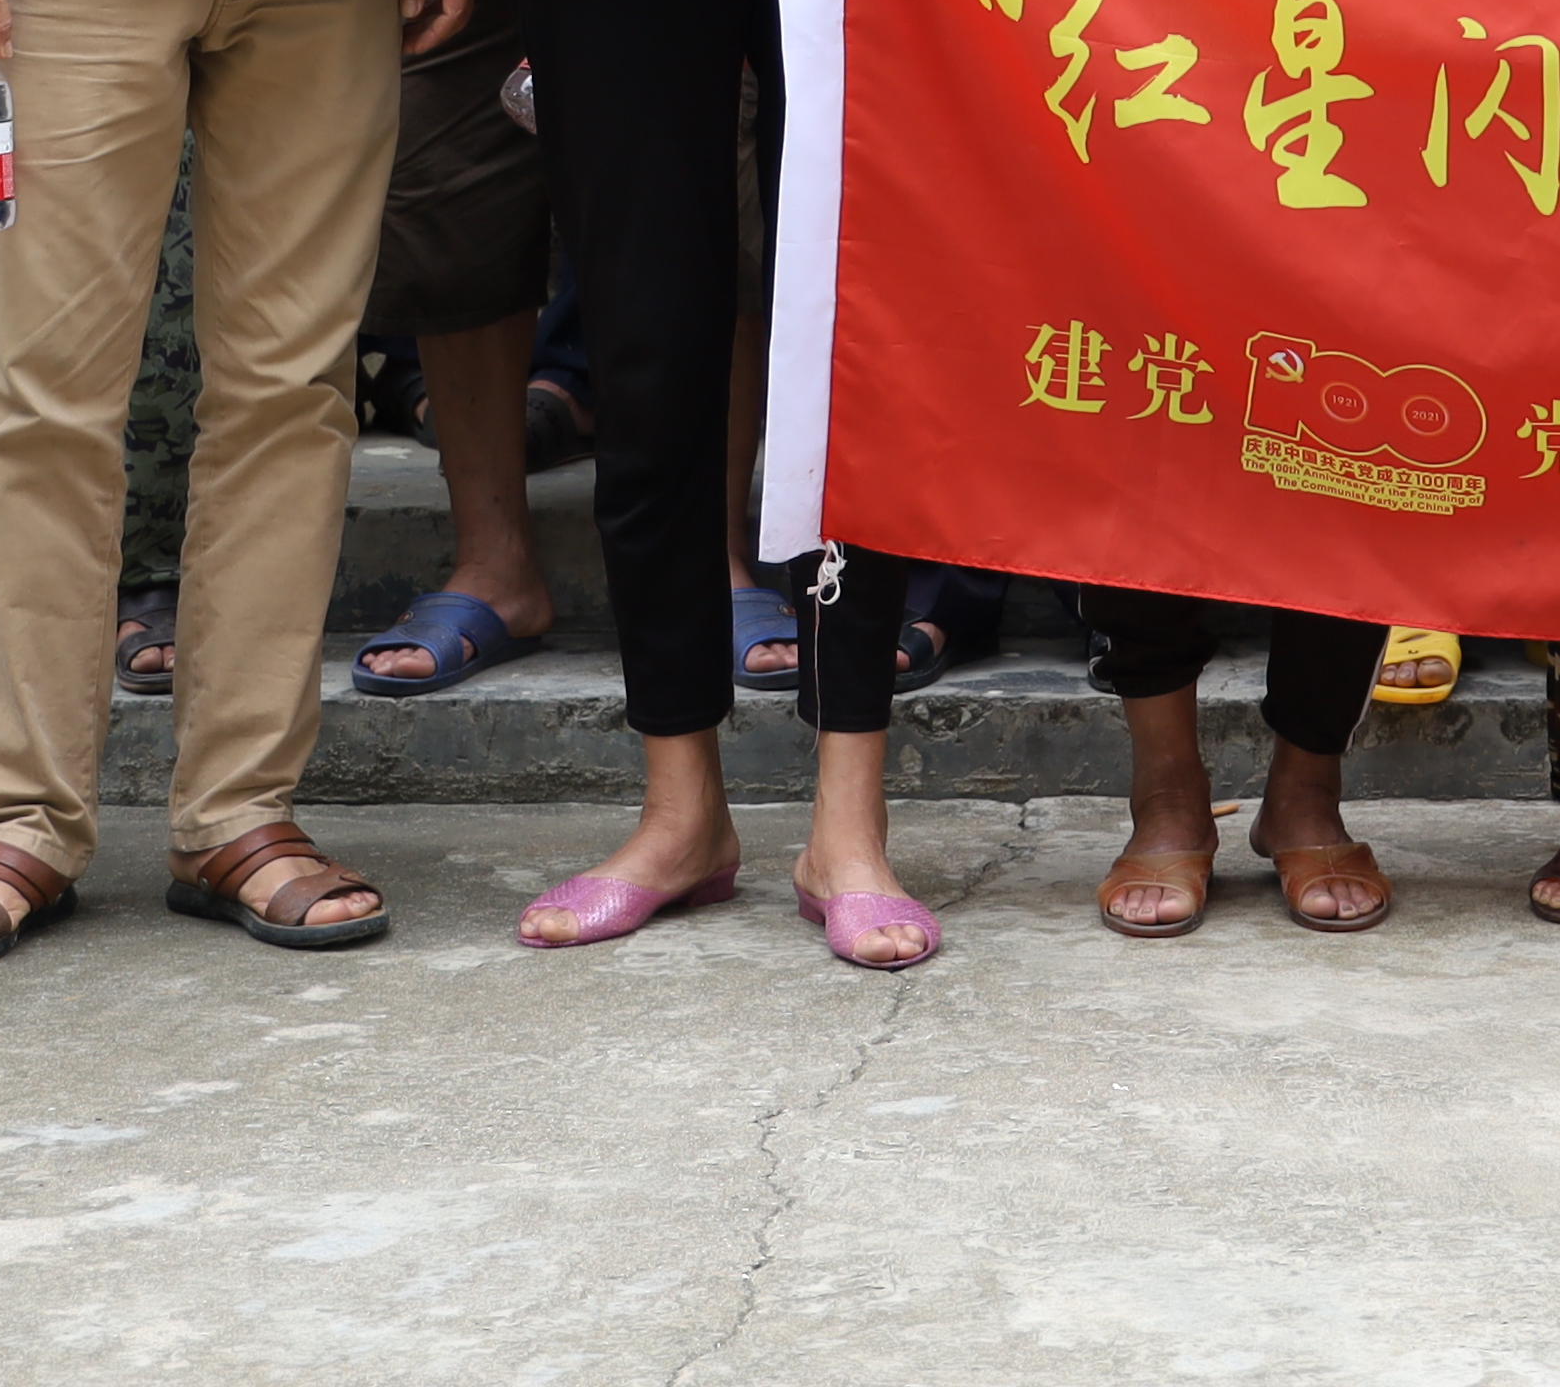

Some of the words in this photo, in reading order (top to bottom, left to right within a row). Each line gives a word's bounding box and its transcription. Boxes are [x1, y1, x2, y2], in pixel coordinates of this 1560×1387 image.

[1016, 319, 1216, 428] 建党
[1332, 394, 1358, 408] 1921
[1411, 410, 1439, 422] 2021
[1244, 437, 1484, 492] 庆祝中国共产党成立100周年
[1244, 459, 1265, 471] The
[1269, 462, 1300, 475] 100th
[1303, 468, 1371, 495] Anniversary
[1374, 483, 1386, 495] of
[1388, 487, 1407, 497] the
[1410, 490, 1465, 506] Founding
[1468, 494, 1480, 505] of
[1276, 476, 1298, 488] The
[1301, 479, 1365, 502] Communist
[1368, 495, 1399, 510] Party
[1402, 499, 1414, 509] of
[1417, 501, 1451, 513] China
